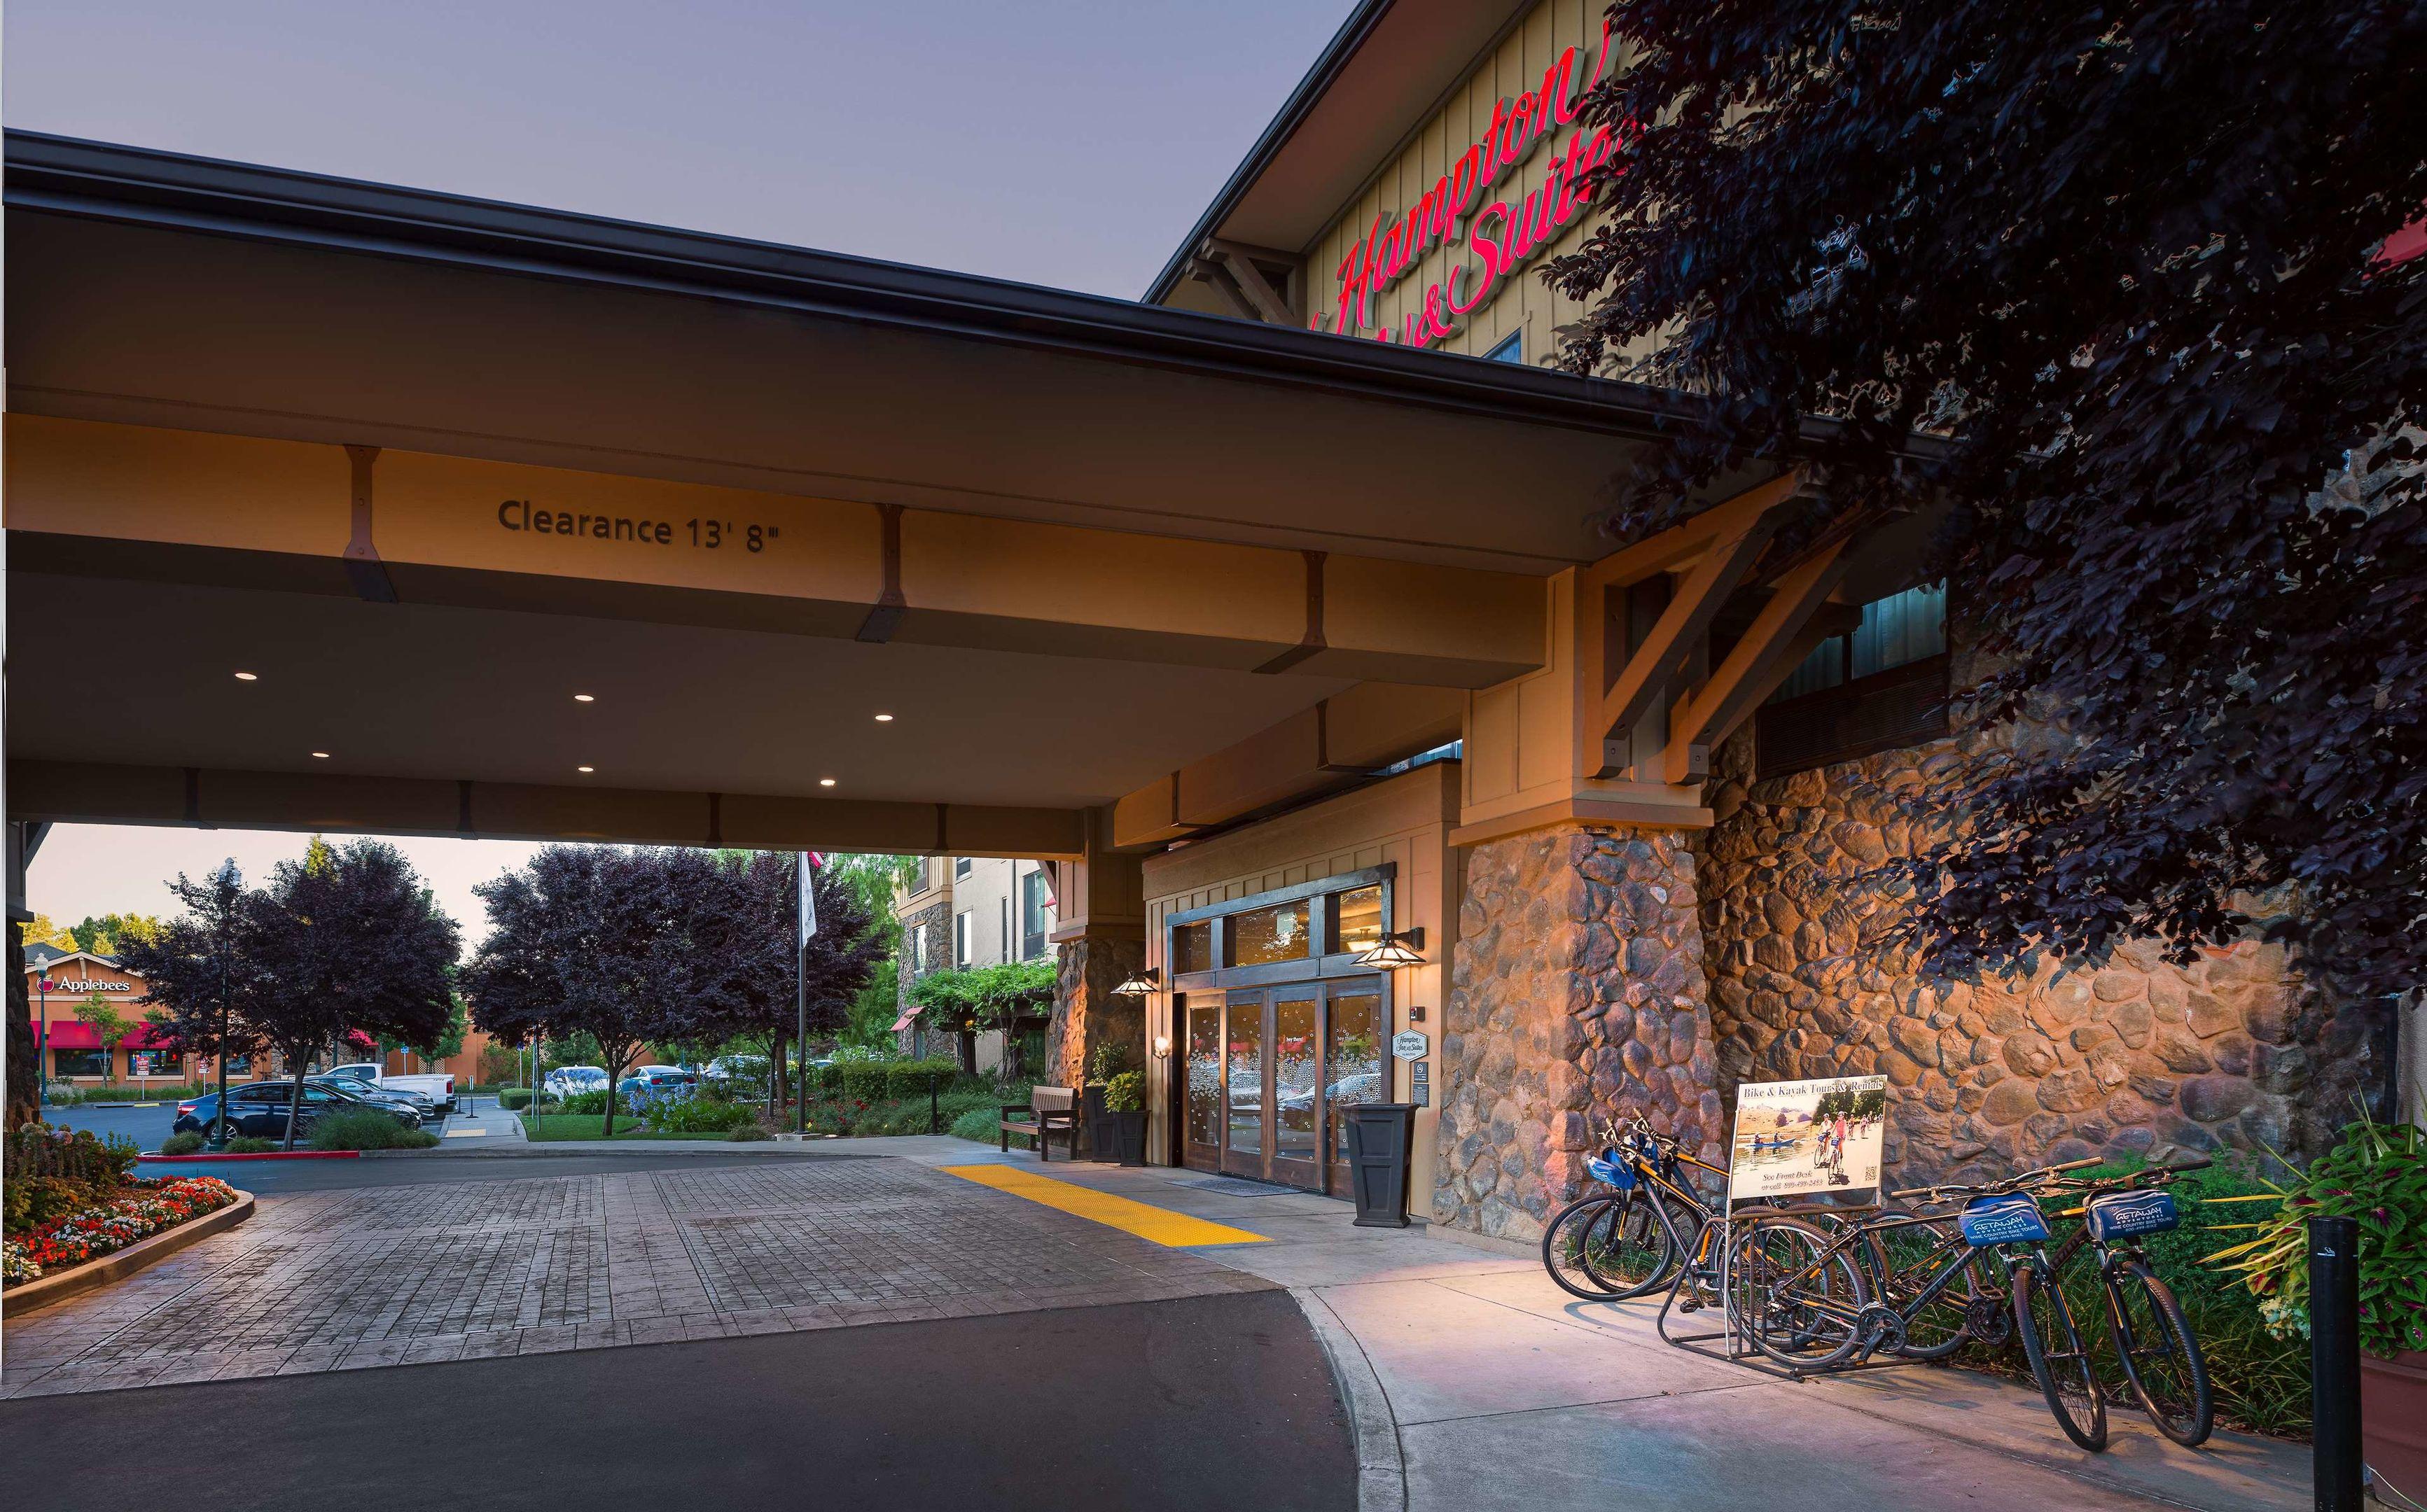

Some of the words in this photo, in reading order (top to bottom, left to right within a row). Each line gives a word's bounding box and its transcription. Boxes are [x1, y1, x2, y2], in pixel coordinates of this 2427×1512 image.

[1311, 20, 1610, 335] Hampton
[1447, 111, 1646, 315] Suite
[498, 500, 672, 545] Clearance
[686, 518, 731, 550] 13'
[59, 976, 130, 993] Applebee's
[1397, 1036, 1421, 1044] Hampton
[1744, 1088, 1765, 1098] Bike
[1767, 1086, 1775, 1096] &
[1779, 1085, 1807, 1098] Kayak
[1810, 1083, 1836, 1093] Tours
[1838, 1082, 1847, 1091] &
[1851, 1079, 1883, 1091] Rentals
[1796, 1170, 1813, 1179] Desk
[2115, 1207, 2162, 1221] GETAWAY
[2117, 1214, 2163, 1224] ADVENTURES
[1974, 1217, 2024, 1231] GETAWAY
[1977, 1223, 2027, 1234] ADVENTURES
